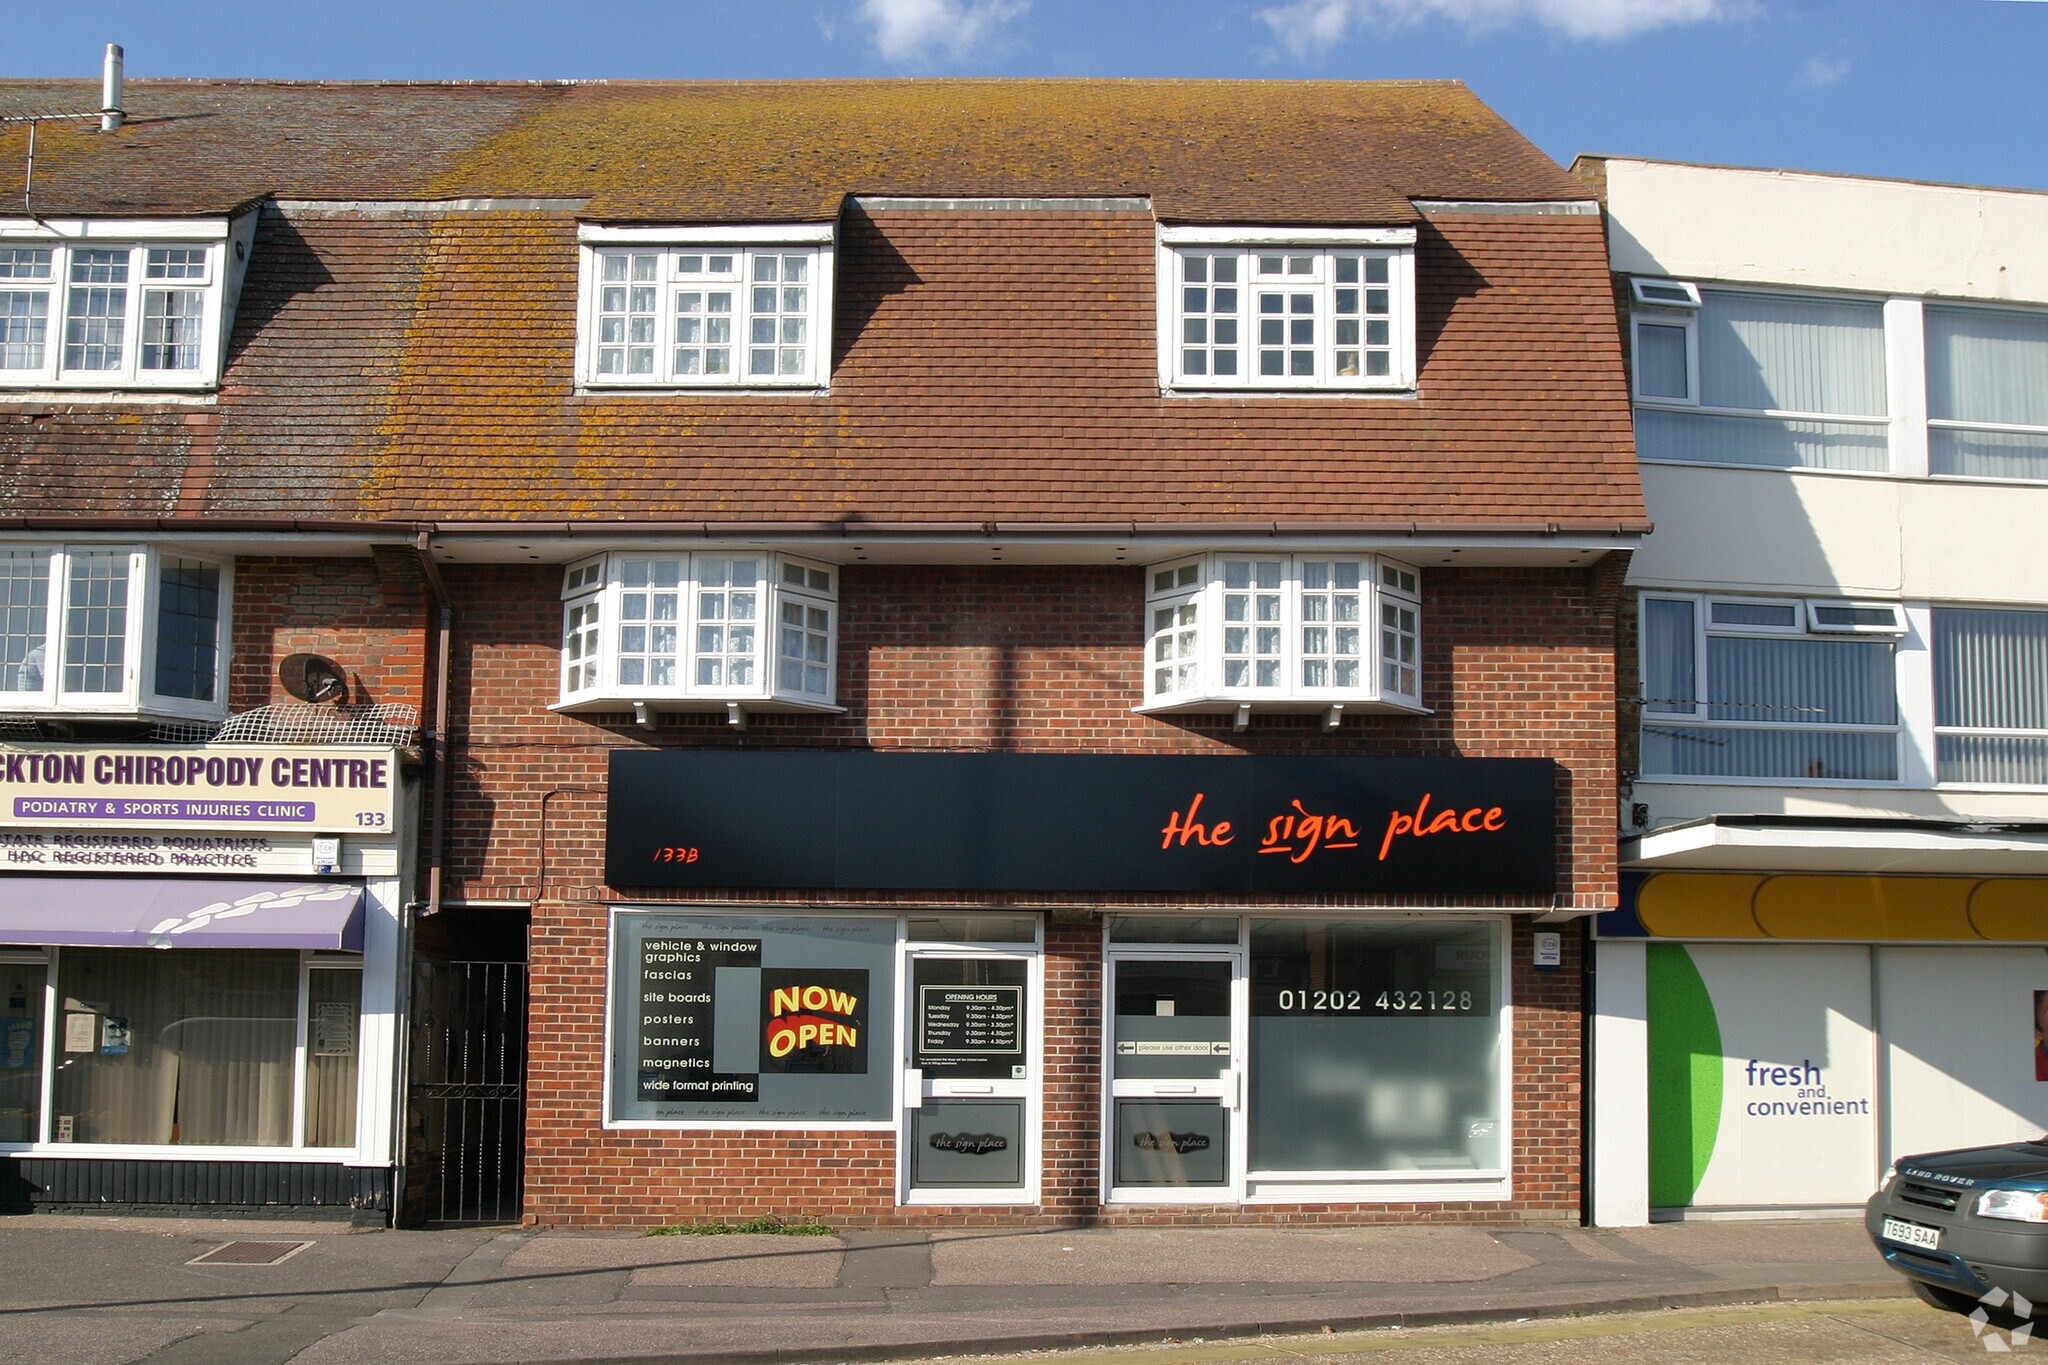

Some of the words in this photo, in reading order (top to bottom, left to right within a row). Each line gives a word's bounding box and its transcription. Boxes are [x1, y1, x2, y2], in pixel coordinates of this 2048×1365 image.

[0, 754, 85, 784] KTON
[94, 755, 263, 786] CHIROPODY
[271, 757, 388, 788] CENTRE
[22, 802, 98, 813] PODIATRY
[105, 803, 116, 814] &
[124, 803, 179, 815] SPORTS
[186, 804, 251, 816] INJURIES
[257, 805, 306, 817] CLINIC
[355, 812, 386, 827] 133
[1161, 793, 1236, 850] the
[1258, 799, 1361, 863] sign
[1378, 792, 1508, 861] place
[53, 835, 153, 847] REGISTERED
[163, 837, 268, 848] PODIATRISTS
[8, 851, 41, 862] HPC
[53, 851, 159, 864] REGISTERED
[170, 853, 252, 865] PRACTICE
[653, 847, 699, 864] 133B
[645, 941, 692, 951] vehicle
[696, 941, 705, 951] &
[710, 942, 757, 952] window
[645, 952, 701, 963] graphics
[644, 970, 692, 979] fascias
[643, 992, 664, 1002] site
[668, 993, 711, 1002] boards
[774, 986, 857, 1017] NOW
[945, 993, 974, 1001] OPENING
[1278, 989, 1361, 1010] 01202
[1375, 990, 1472, 1010] 432128
[644, 1014, 694, 1025] posters
[643, 1036, 700, 1046] banners
[769, 1023, 857, 1057] OPEN
[1138, 1044, 1161, 1052] please
[643, 1058, 710, 1069] magnetics
[1745, 1059, 1820, 1086] fresh
[643, 1081, 670, 1090] wide
[673, 1080, 709, 1090] format
[712, 1081, 754, 1092] printing
[1797, 1084, 1826, 1098] and
[1747, 1096, 1869, 1116] convenient
[936, 1134, 952, 1148] the
[955, 1137, 975, 1153] sign
[977, 1137, 1004, 1153] place
[1180, 1137, 1207, 1152] place
[1905, 1168, 1933, 1179] LAND
[1934, 1173, 1976, 1186] ROVER
[1887, 1221, 1912, 1240] T693
[1913, 1228, 1936, 1246] SAA
